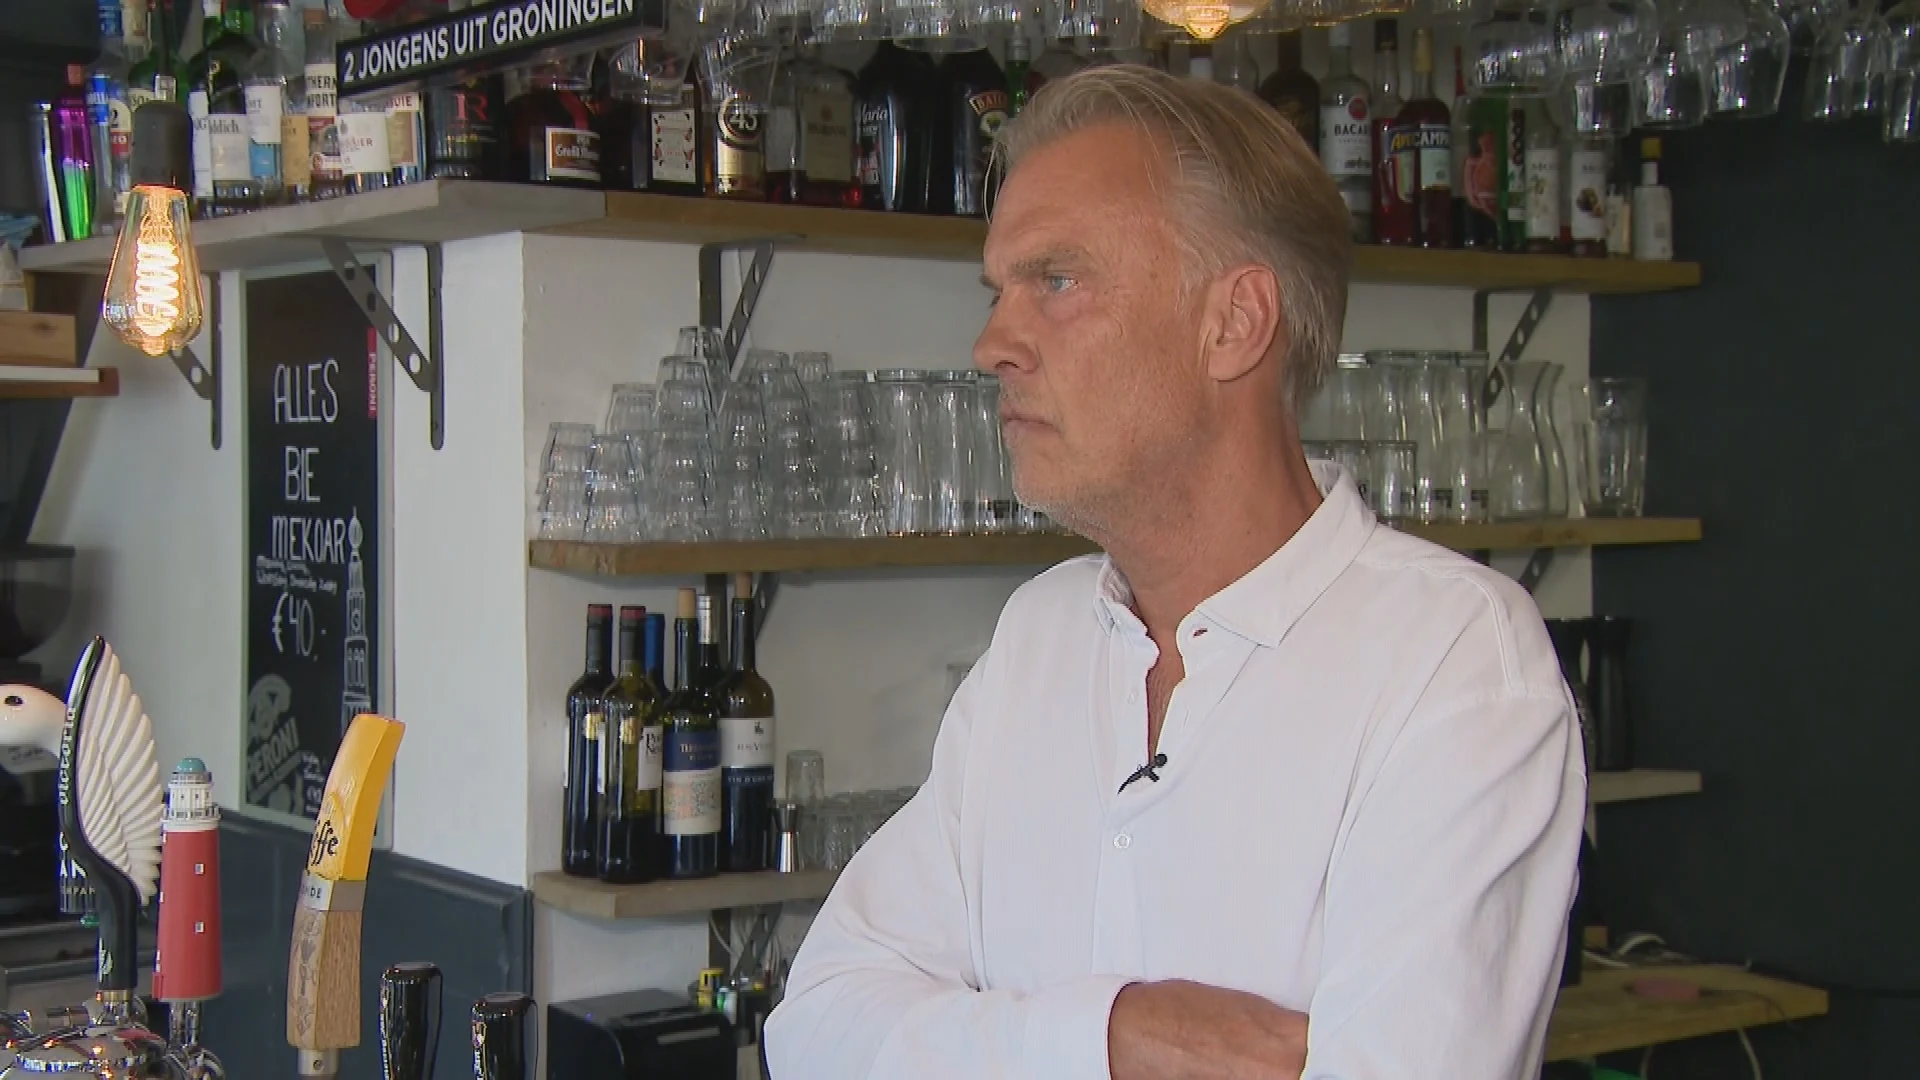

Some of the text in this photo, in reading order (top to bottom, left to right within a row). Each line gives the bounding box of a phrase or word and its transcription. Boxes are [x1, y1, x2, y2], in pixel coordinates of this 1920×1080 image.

[344, 51, 355, 83] 2
[358, 26, 450, 79] JONGENS
[453, 15, 489, 55] UIT
[274, 359, 339, 424] ALLES
[369, 352, 377, 412] PERONI
[284, 446, 321, 502] BIE
[271, 516, 346, 564] MEKOAR
